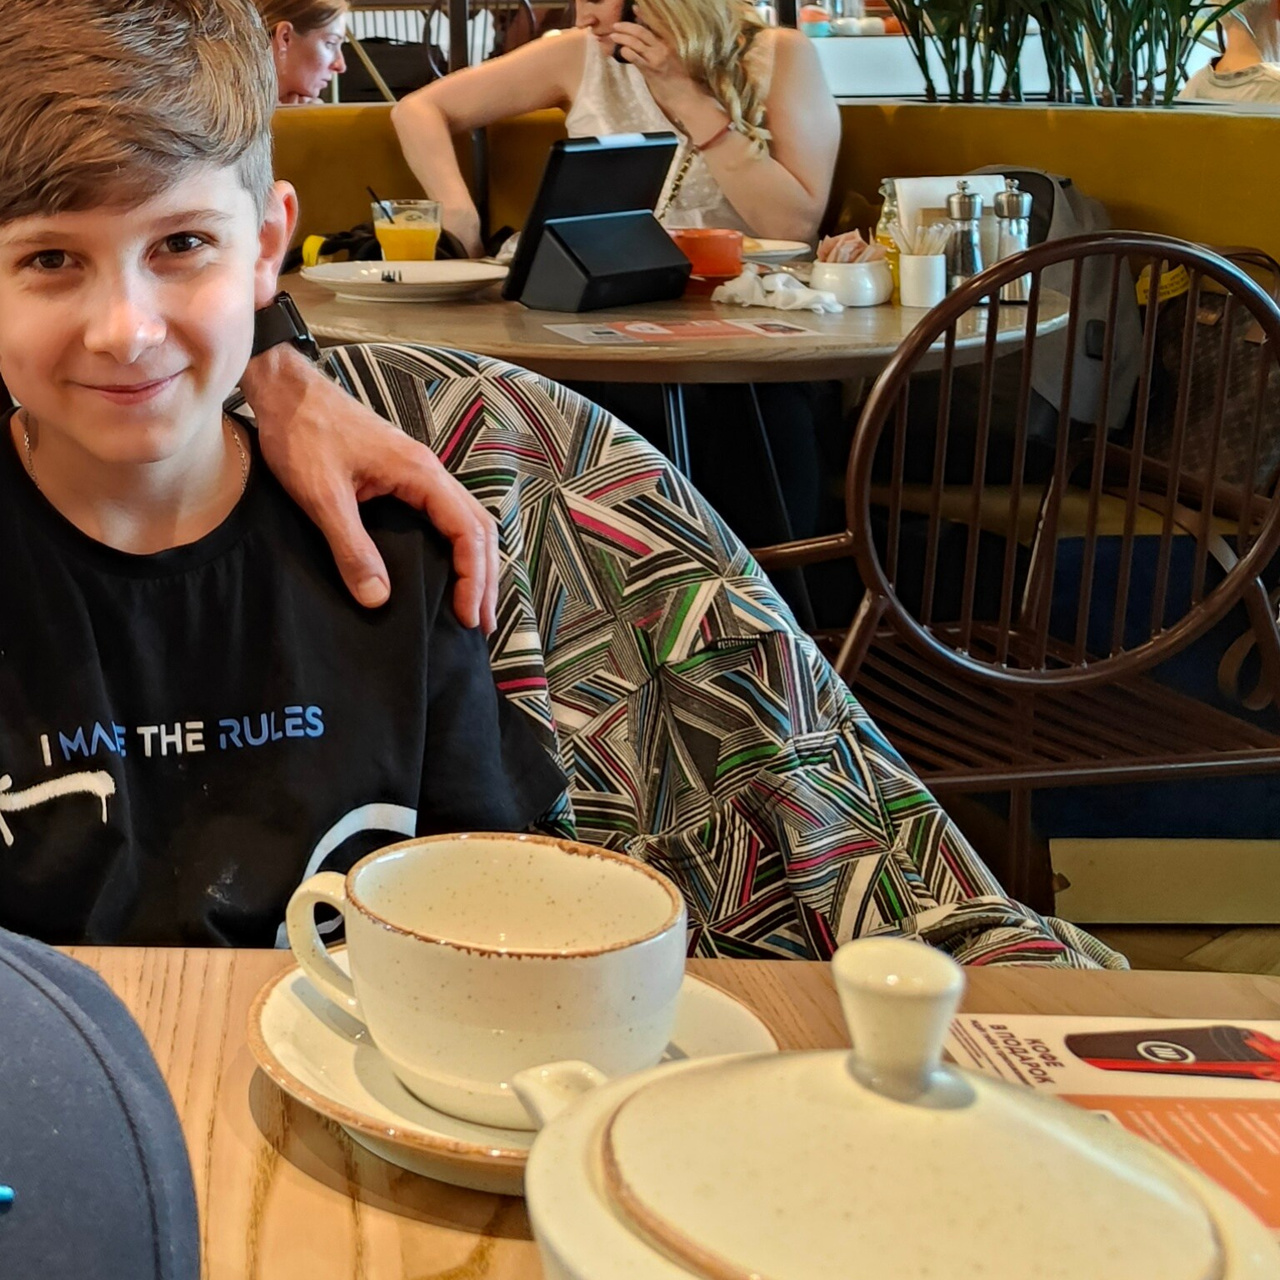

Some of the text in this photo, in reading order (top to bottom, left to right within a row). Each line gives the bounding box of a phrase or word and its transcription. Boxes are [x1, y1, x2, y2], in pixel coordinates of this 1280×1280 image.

[40, 733, 52, 767] I
[136, 721, 205, 757] THE
[219, 705, 324, 750] RULES
[994, 1032, 1056, 1084] ПОДАРОК
[1023, 1037, 1066, 1068] КОФЕ
